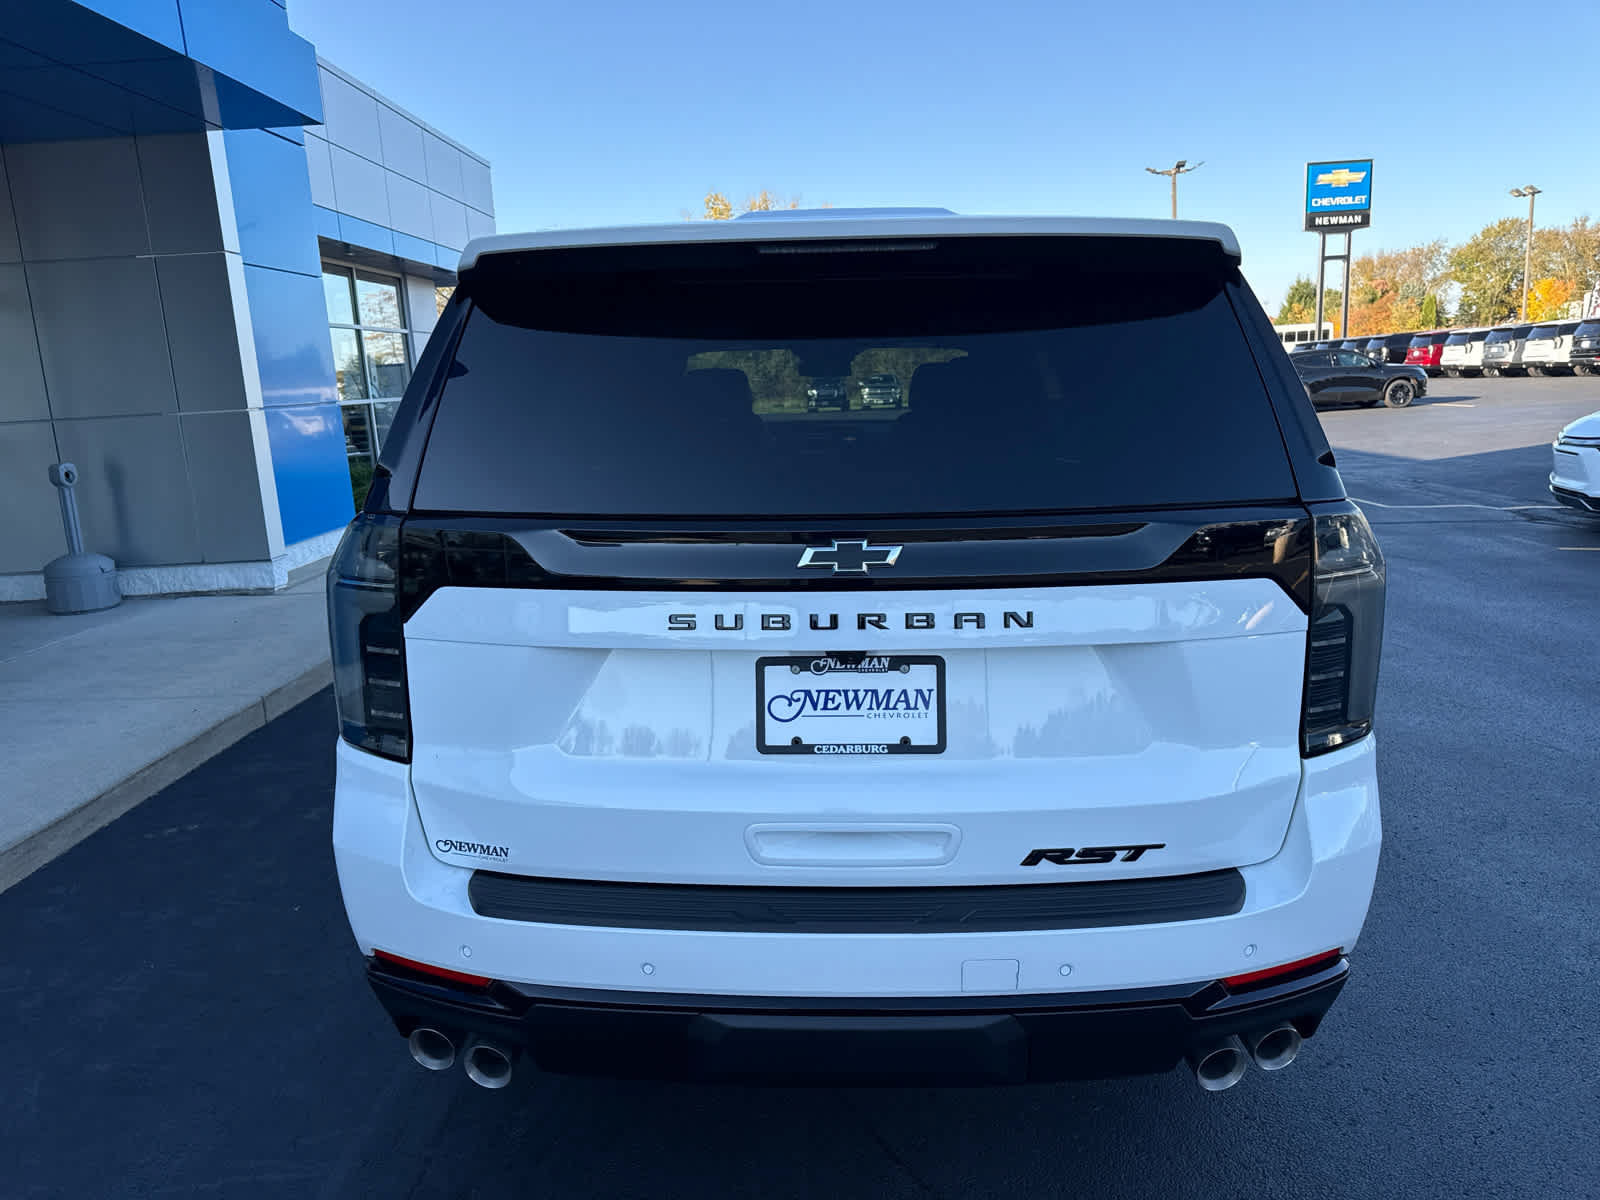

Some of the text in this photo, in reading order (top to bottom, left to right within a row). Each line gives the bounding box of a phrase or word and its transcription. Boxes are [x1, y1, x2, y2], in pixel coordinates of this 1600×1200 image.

[1311, 195, 1367, 207] CHEVROLET
[1315, 215, 1361, 225] NEWMAN
[668, 611, 1034, 631] SUBURBAN
[767, 688, 934, 722] NEWMAN
[814, 745, 889, 754] CEDARBURG
[435, 839, 509, 857] NEWMAN
[1019, 843, 1166, 866] RST
